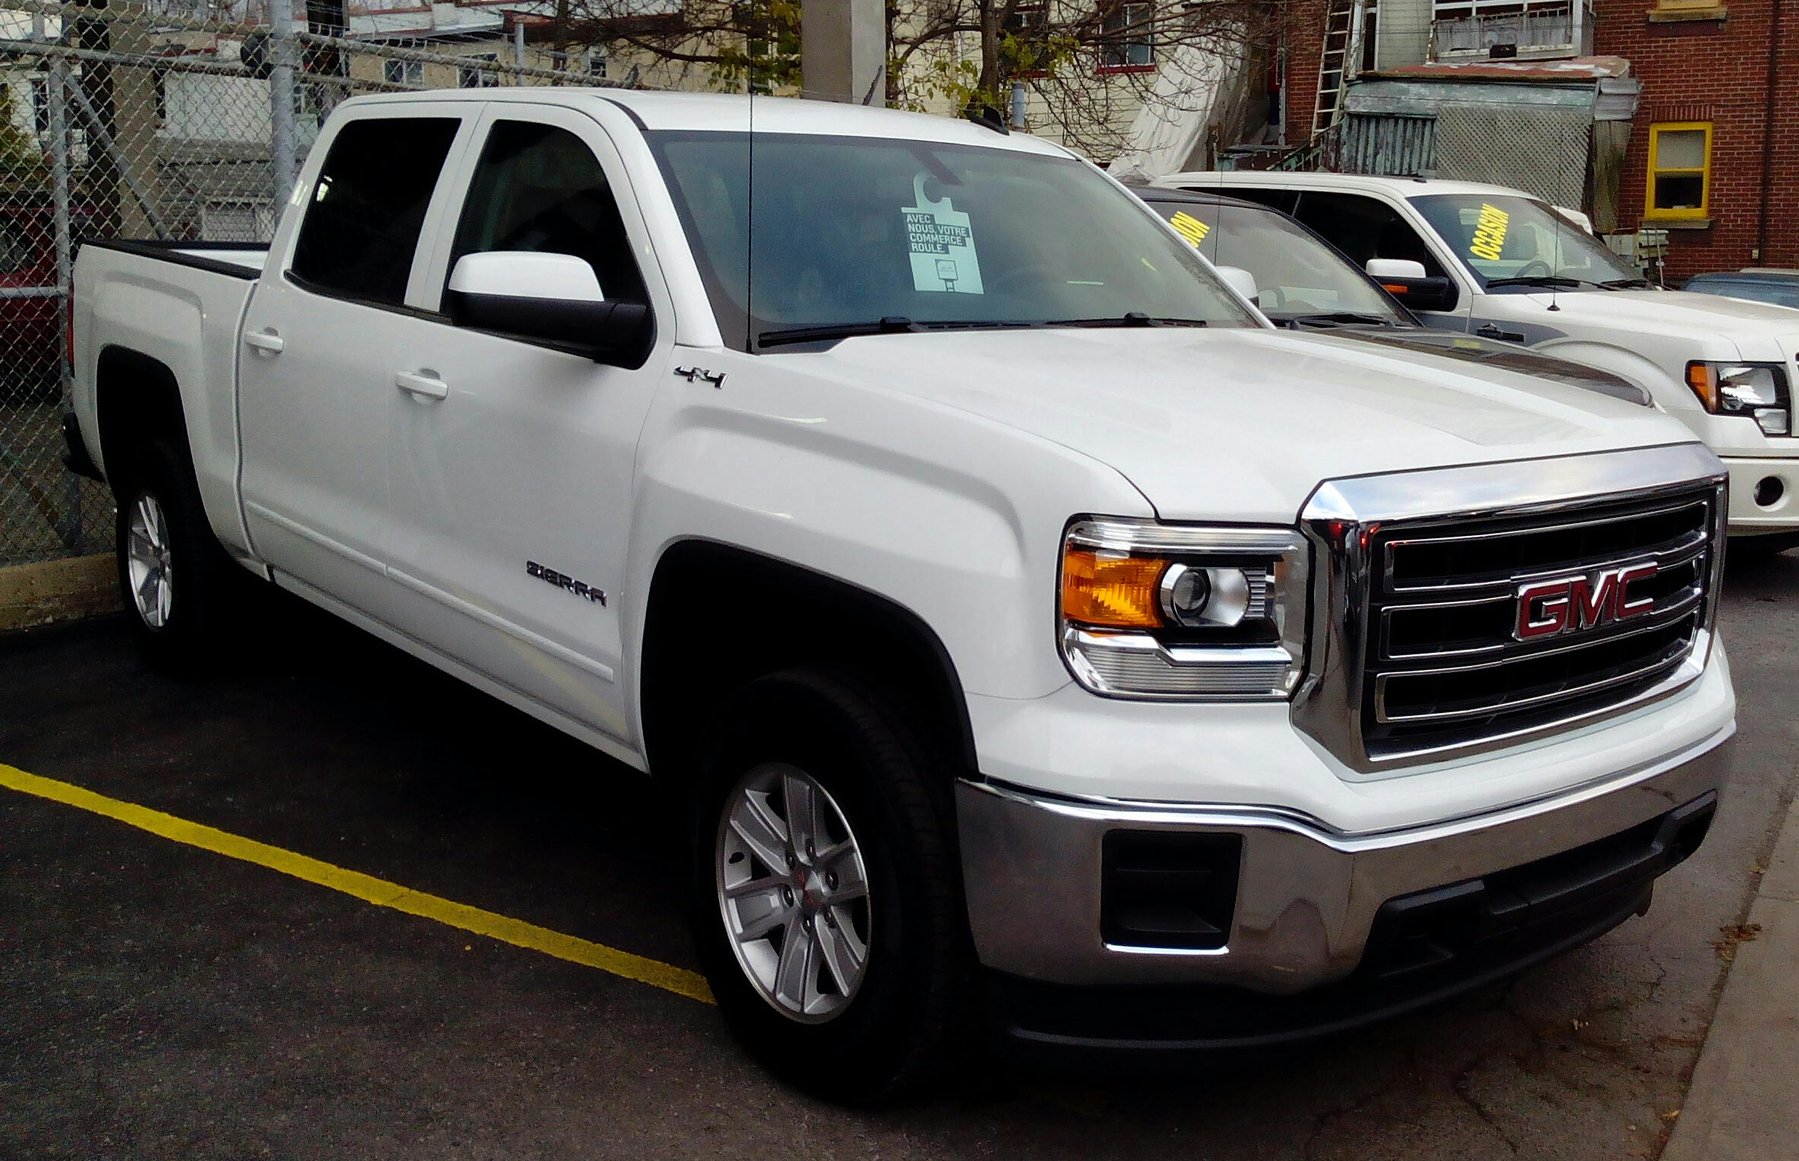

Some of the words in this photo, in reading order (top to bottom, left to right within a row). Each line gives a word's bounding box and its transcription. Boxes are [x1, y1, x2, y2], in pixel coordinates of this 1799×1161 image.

[906, 213, 931, 224] AVEC
[907, 223, 937, 235] NOUS,
[937, 225, 967, 237] VOTRE
[1469, 203, 1509, 261] OCCASION
[909, 232, 963, 246] COMMERCE
[526, 560, 607, 608] SIERRA
[1512, 561, 1658, 641] GMC
